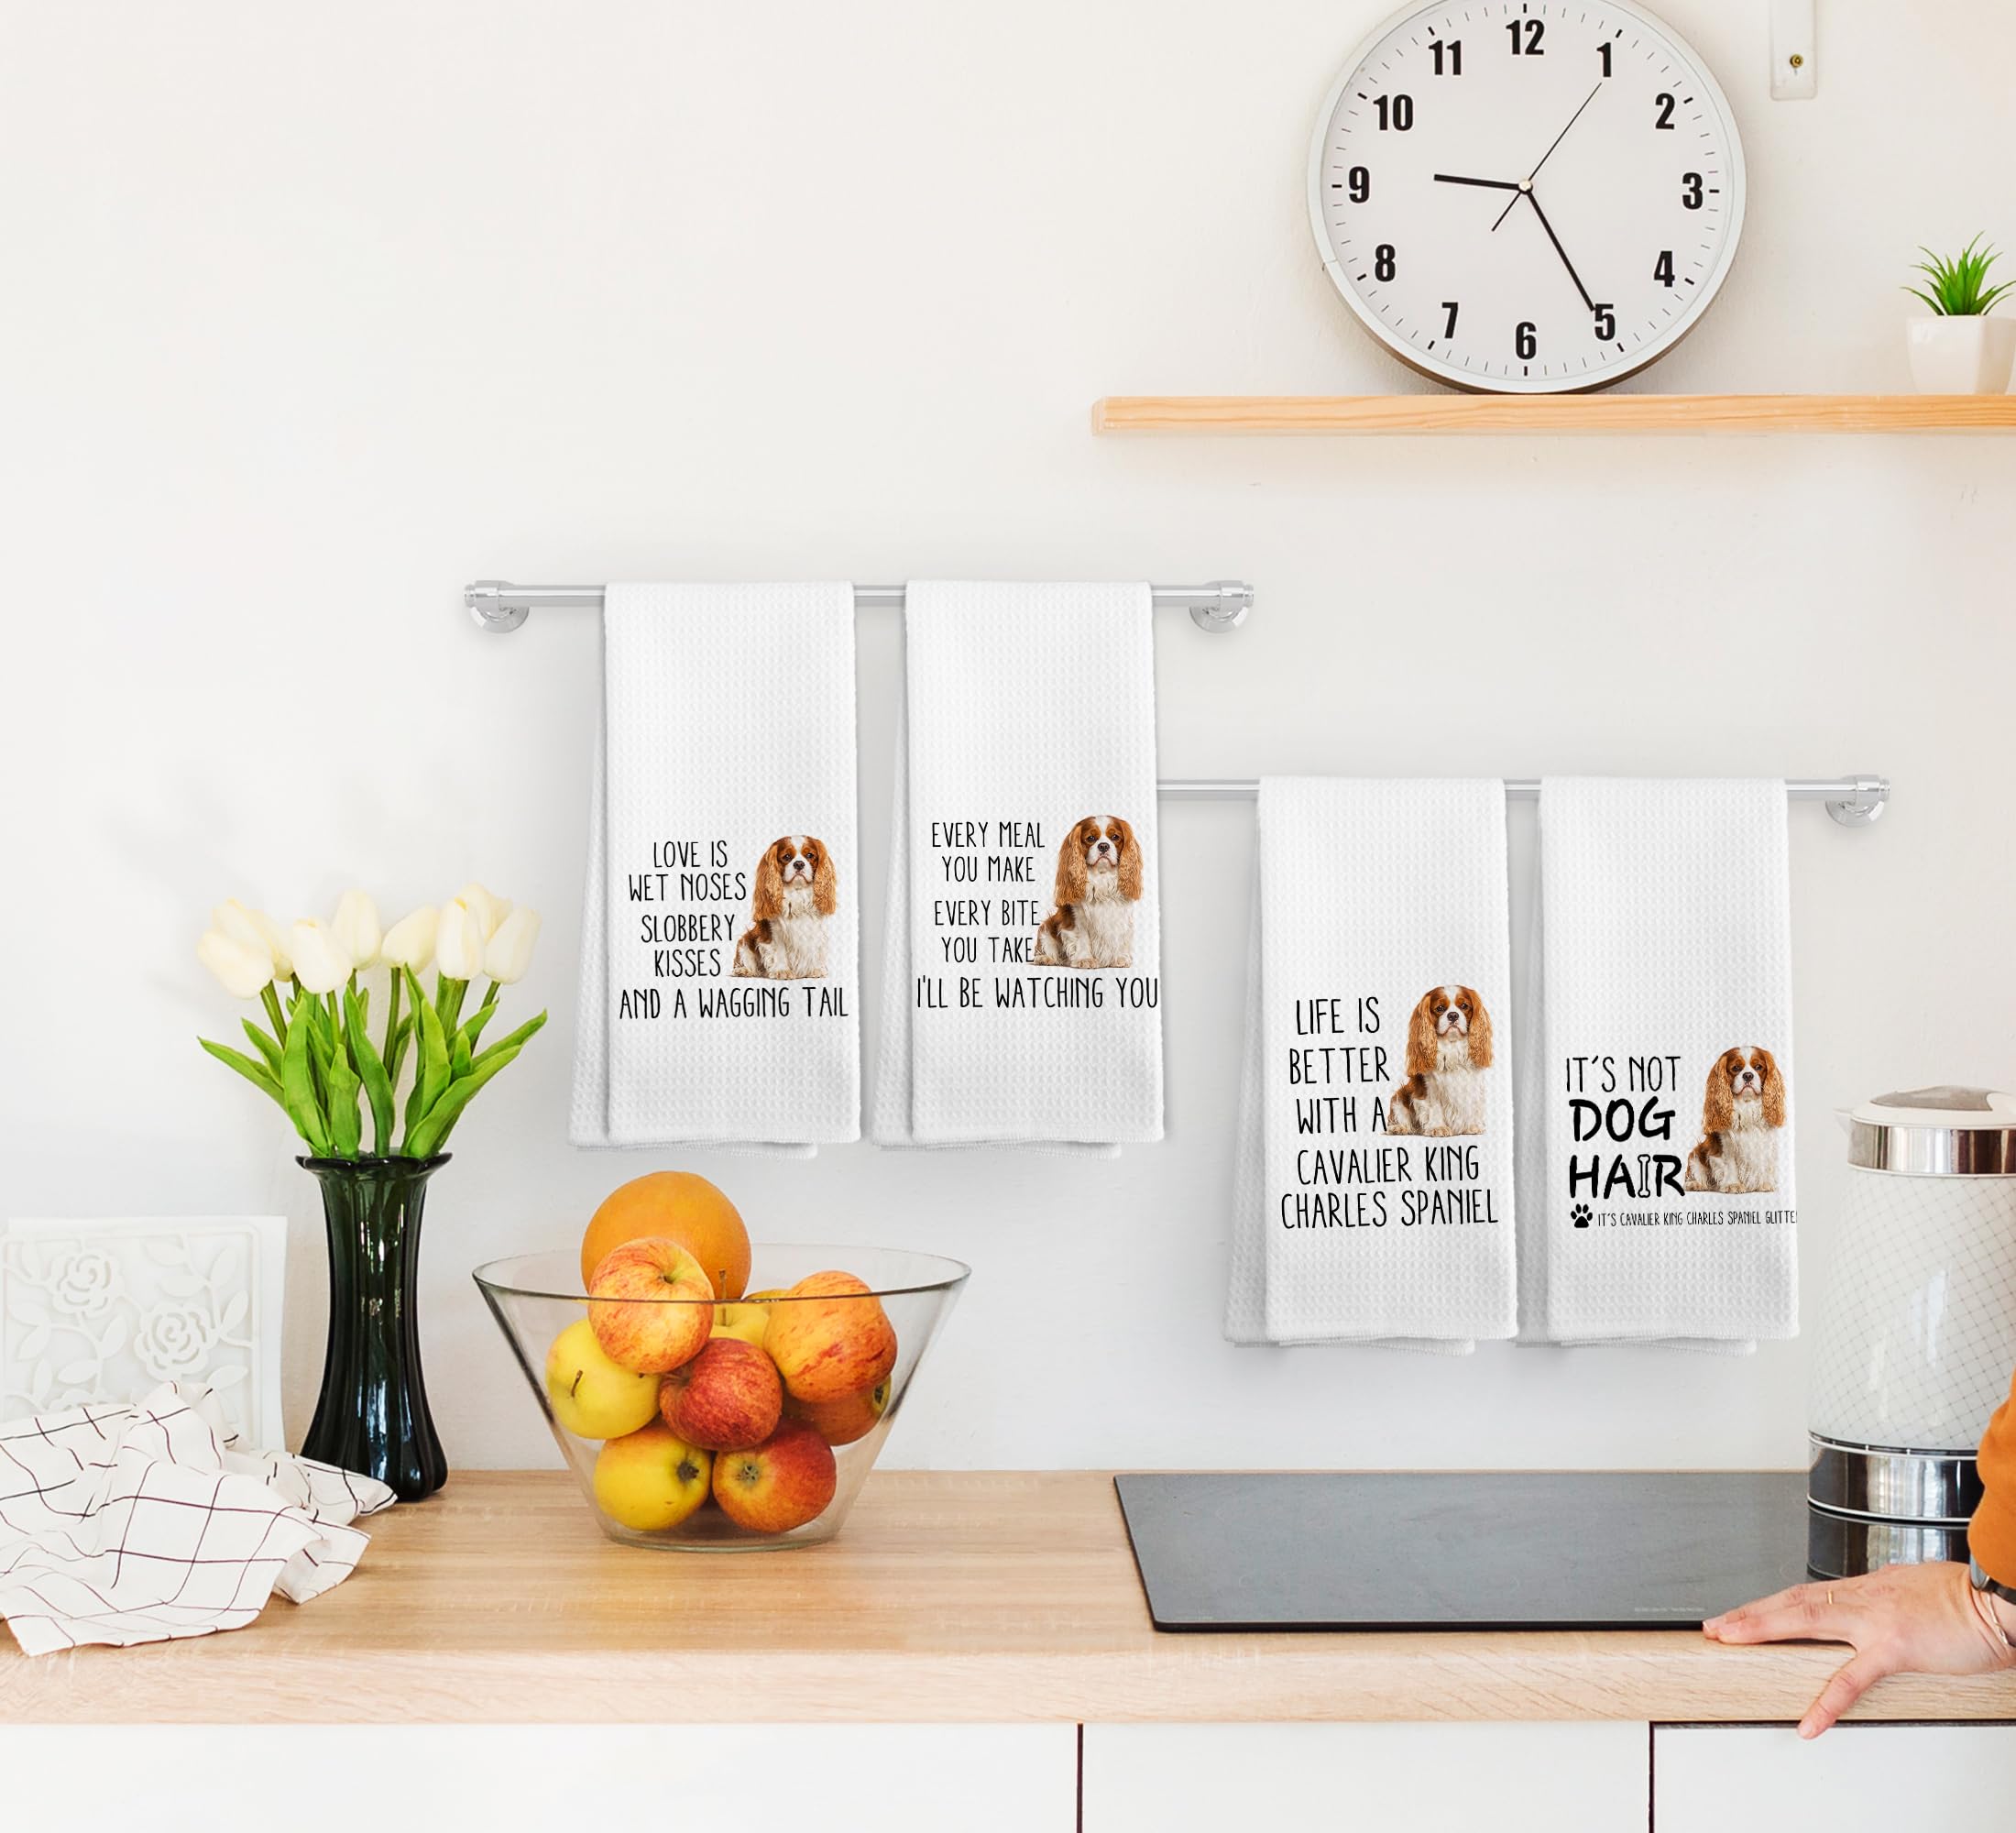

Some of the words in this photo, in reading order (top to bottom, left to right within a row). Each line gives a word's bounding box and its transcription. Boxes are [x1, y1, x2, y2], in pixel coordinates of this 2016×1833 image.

[1506, 19, 1544, 55] 12
[1429, 40, 1461, 75] 11
[1597, 42, 1611, 77] 1
[1374, 94, 1413, 131] 10
[1656, 93, 1675, 129] 2
[1349, 167, 1369, 203] 9
[1682, 172, 1703, 210] 3
[1375, 244, 1396, 282] 8
[1654, 251, 1675, 287] 4
[1442, 302, 1458, 338] 7
[1594, 303, 1615, 341] 5
[1516, 322, 1536, 359] 6
[932, 822, 988, 848] EVERY
[1000, 821, 1045, 848] MEAL
[654, 841, 700, 868] LOVE
[712, 840, 727, 868] IS
[942, 856, 977, 882] YOU
[989, 856, 1035, 882] MAKE
[629, 874, 668, 902] WET
[681, 873, 746, 901] NOSES
[641, 914, 735, 942] SLOBBERY
[935, 900, 991, 926] EVERY
[1003, 900, 1041, 926] BITE
[655, 949, 720, 977] KISSES
[941, 937, 976, 962] YOU
[988, 937, 1035, 963] TAKE
[619, 989, 660, 1019] AND
[674, 989, 686, 1018] A
[699, 987, 789, 1018] WAGGING
[802, 987, 849, 1016] TAIL
[918, 975, 948, 1008] I'LL
[960, 977, 982, 1007] BE
[995, 977, 1102, 1008] WATCHING
[1116, 977, 1157, 1008] YOU
[1297, 999, 1344, 1035] LIFE
[1359, 997, 1379, 1033] IS
[1290, 1047, 1389, 1084] BETTER
[1629, 1056, 1681, 1092] NOT
[1297, 1096, 1356, 1134] WITH
[1373, 1097, 1387, 1133] A
[1569, 1096, 1675, 1142] DOG
[1298, 1147, 1412, 1185] CAVALIER
[1426, 1146, 1478, 1181] KING
[1570, 1154, 1685, 1199] HAIR
[1282, 1191, 1386, 1229] CHARLES
[1401, 1189, 1498, 1226] SPANIEL
[1620, 1213, 1660, 1225] CAVALIER
[1664, 1213, 1682, 1225] KING
[1687, 1212, 1723, 1224] CHARLES
[1728, 1212, 1761, 1224] SPANIEL
[1766, 1211, 1797, 1224] GLITTE
